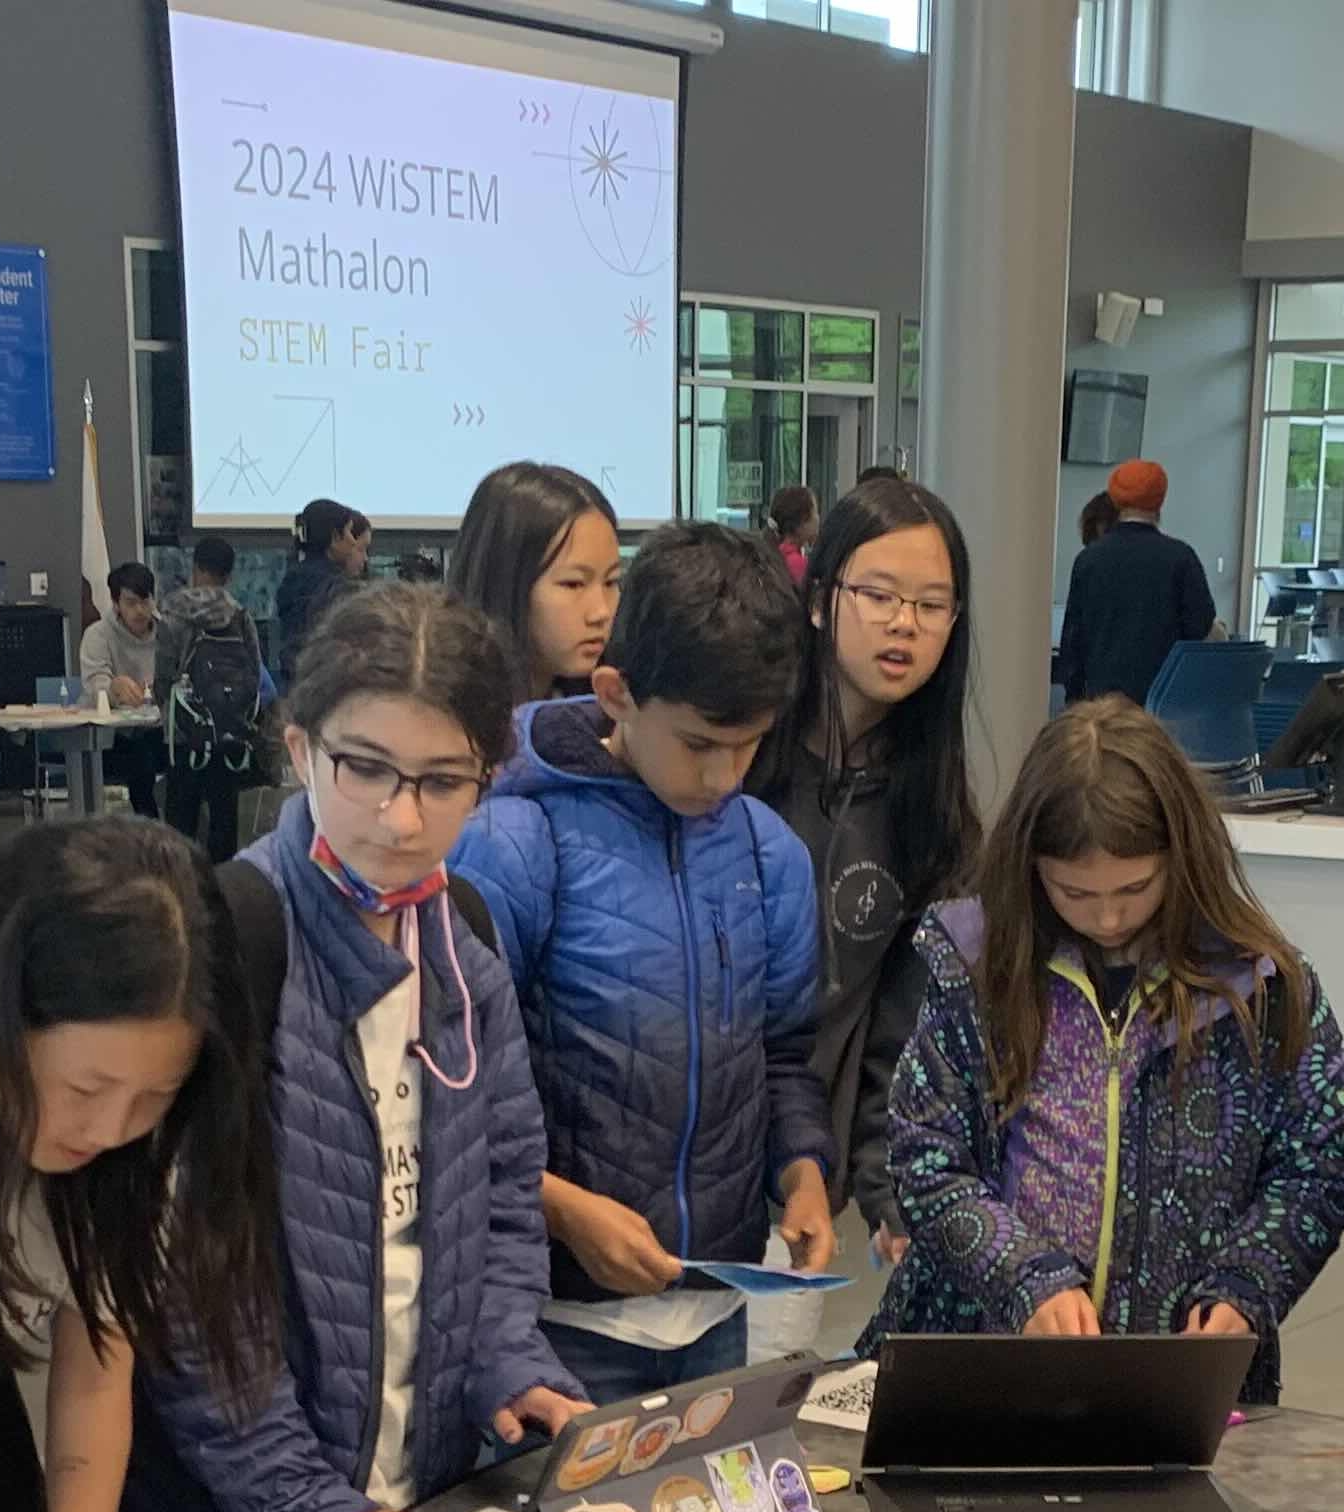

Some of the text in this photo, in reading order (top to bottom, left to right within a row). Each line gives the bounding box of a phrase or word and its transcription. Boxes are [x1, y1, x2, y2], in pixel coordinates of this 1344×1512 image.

[232, 138, 500, 224] 2024 WiSTEM
[238, 226, 430, 297] Mathalon
[239, 317, 432, 373] STEM Fair
